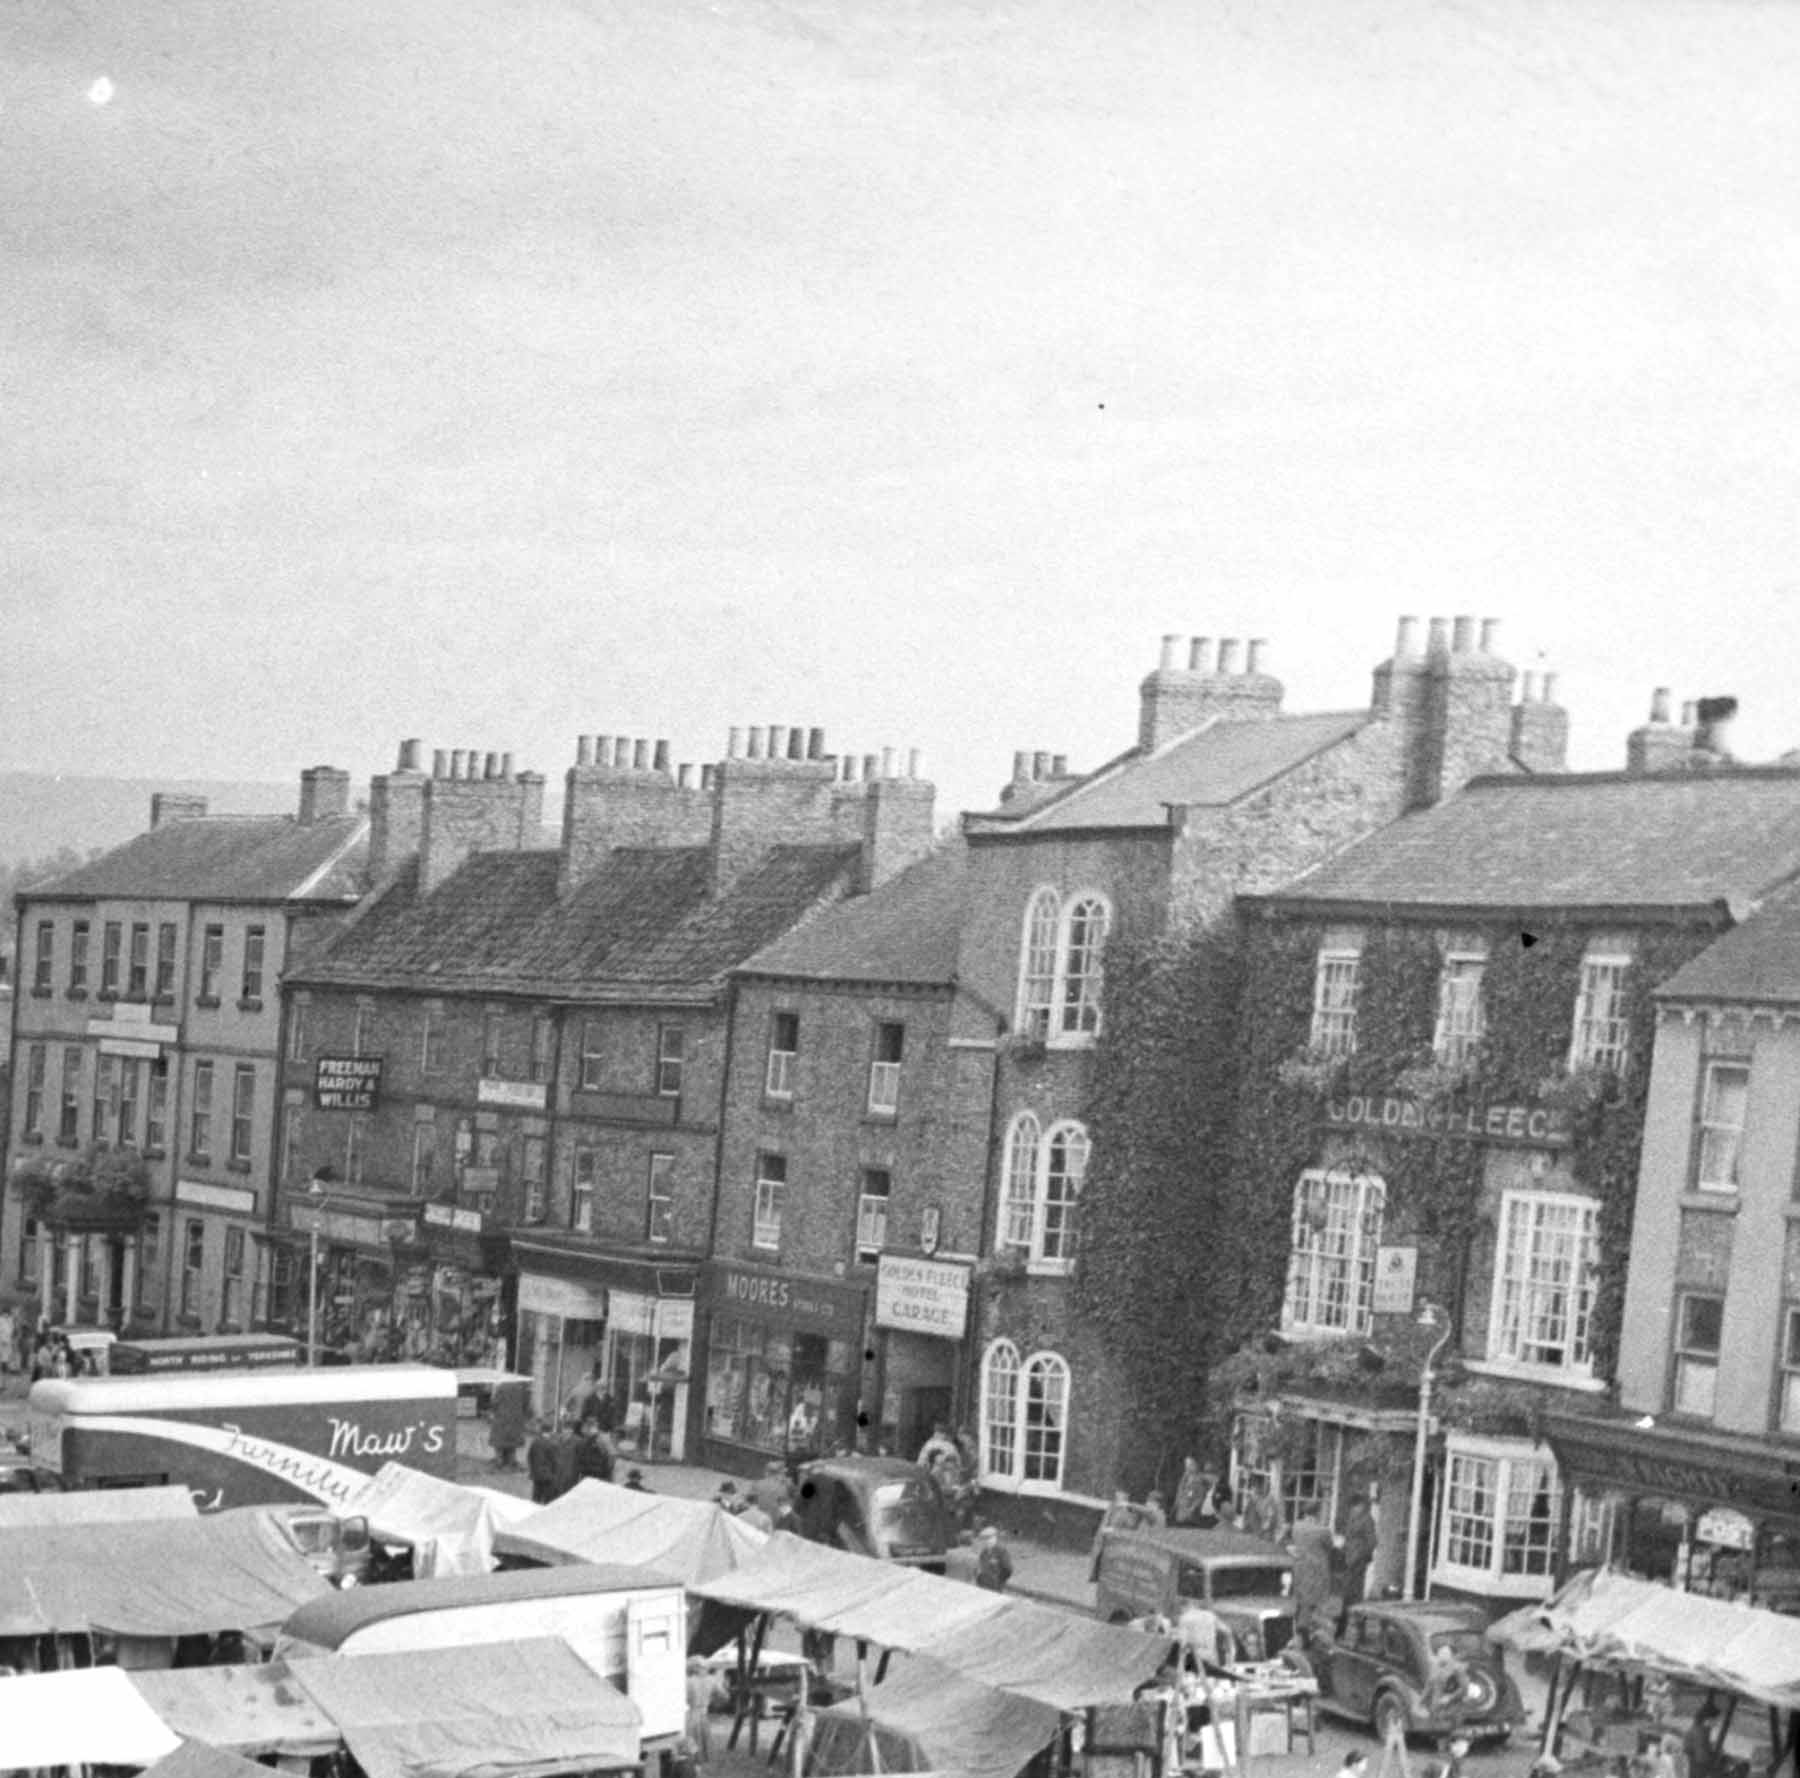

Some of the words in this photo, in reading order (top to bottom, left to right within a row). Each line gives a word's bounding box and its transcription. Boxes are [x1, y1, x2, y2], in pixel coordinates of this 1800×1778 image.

[319, 1060, 380, 1075] FREEMAN
[318, 1077, 362, 1091] HARDY
[320, 1093, 371, 1107] WILLIS
[726, 1273, 789, 1307] MOORES
[893, 1302, 951, 1324] GARAGE
[150, 1355, 183, 1367] NORTH
[328, 1418, 444, 1457] Maw's
